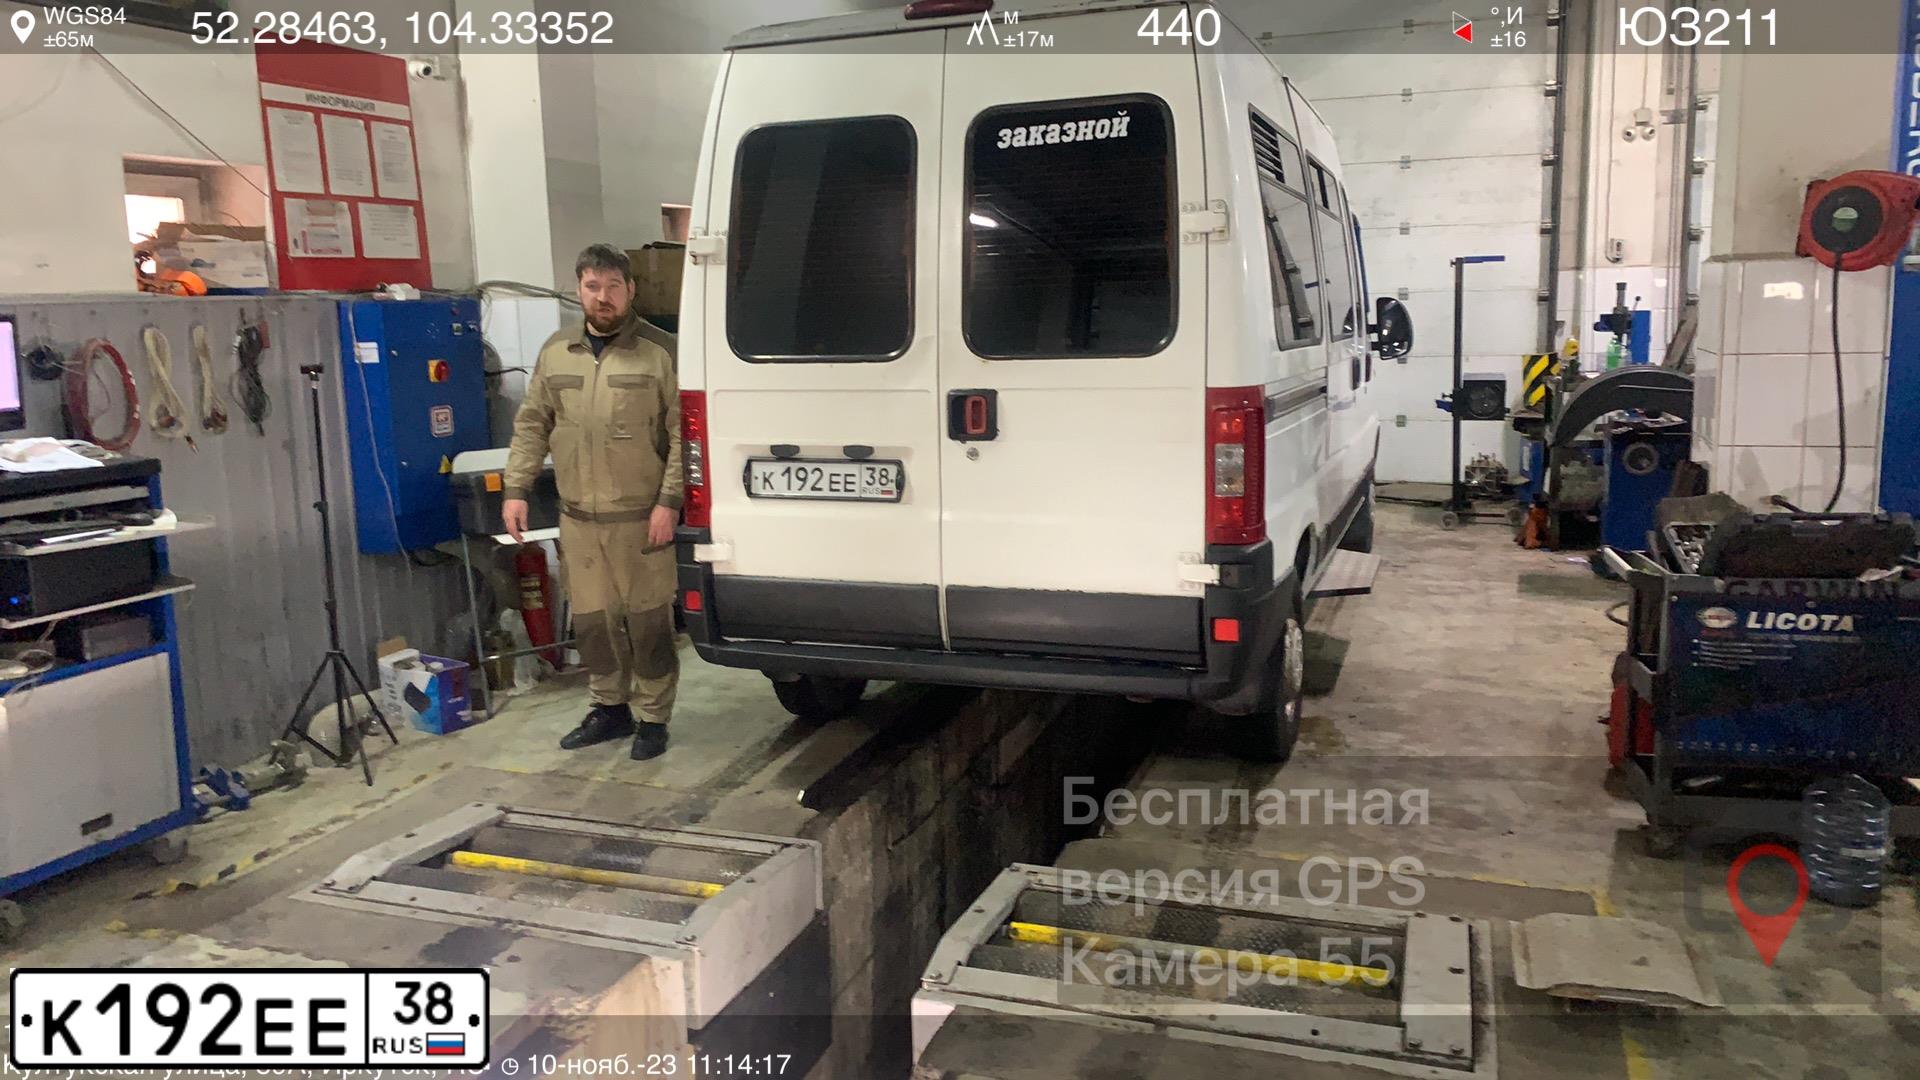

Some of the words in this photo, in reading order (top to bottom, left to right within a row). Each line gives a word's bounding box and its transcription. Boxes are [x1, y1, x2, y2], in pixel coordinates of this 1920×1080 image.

[997, 110, 1131, 149] заказной
[865, 467, 890, 487] 38
[1746, 611, 1854, 632] LICOTA
